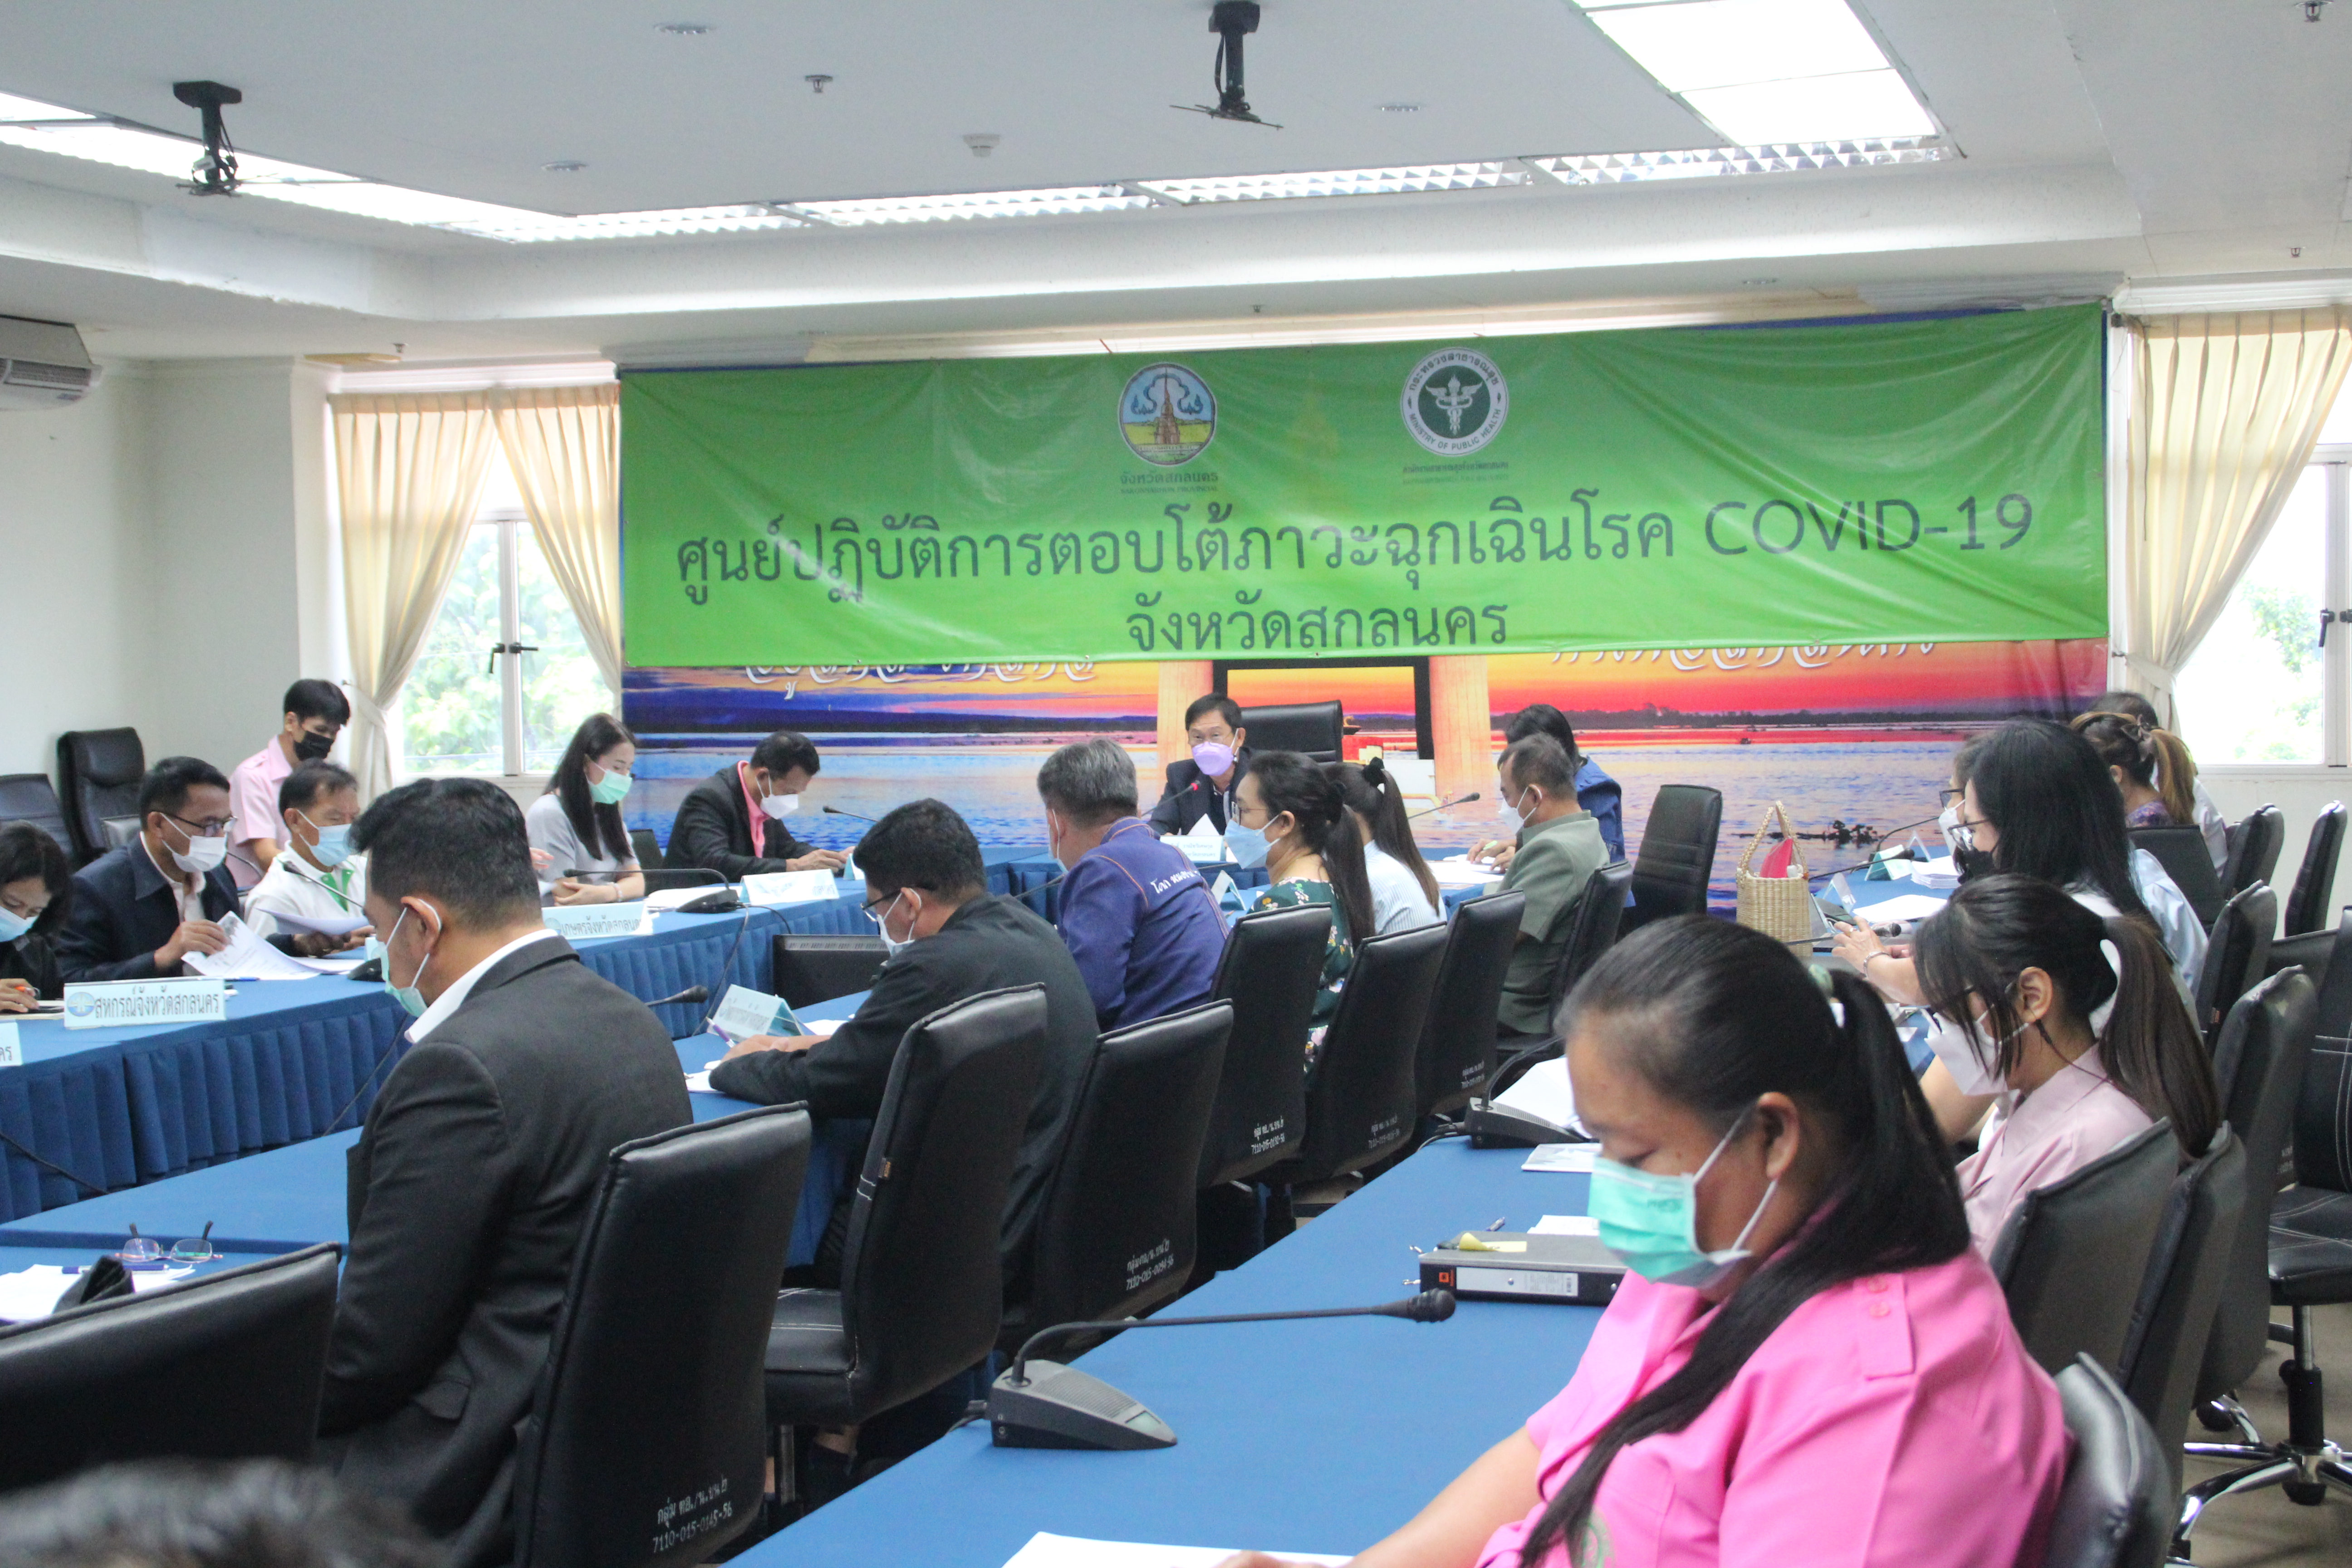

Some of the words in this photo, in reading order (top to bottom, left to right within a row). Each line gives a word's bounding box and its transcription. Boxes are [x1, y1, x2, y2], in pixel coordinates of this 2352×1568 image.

[1409, 353, 1499, 391] กระทรวงสาธารณสุข
[1409, 412, 1436, 445] MINISTRY
[1437, 441, 1448, 449] OF
[1452, 436, 1480, 450] PUBLIC
[1480, 409, 1501, 438] HEALTH
[1120, 470, 1218, 484] จังหวัดสกลนคร
[676, 488, 1674, 605] ศูนย์ปฏิบัติการตอบโต้ภาวะฉุกเฉินโรค
[1705, 494, 2033, 556] COVID-19
[1125, 588, 1508, 652] จังหวัดสกลนคร
[95, 985, 220, 1019] สหกรณ์จังหวัดสกลนคร
